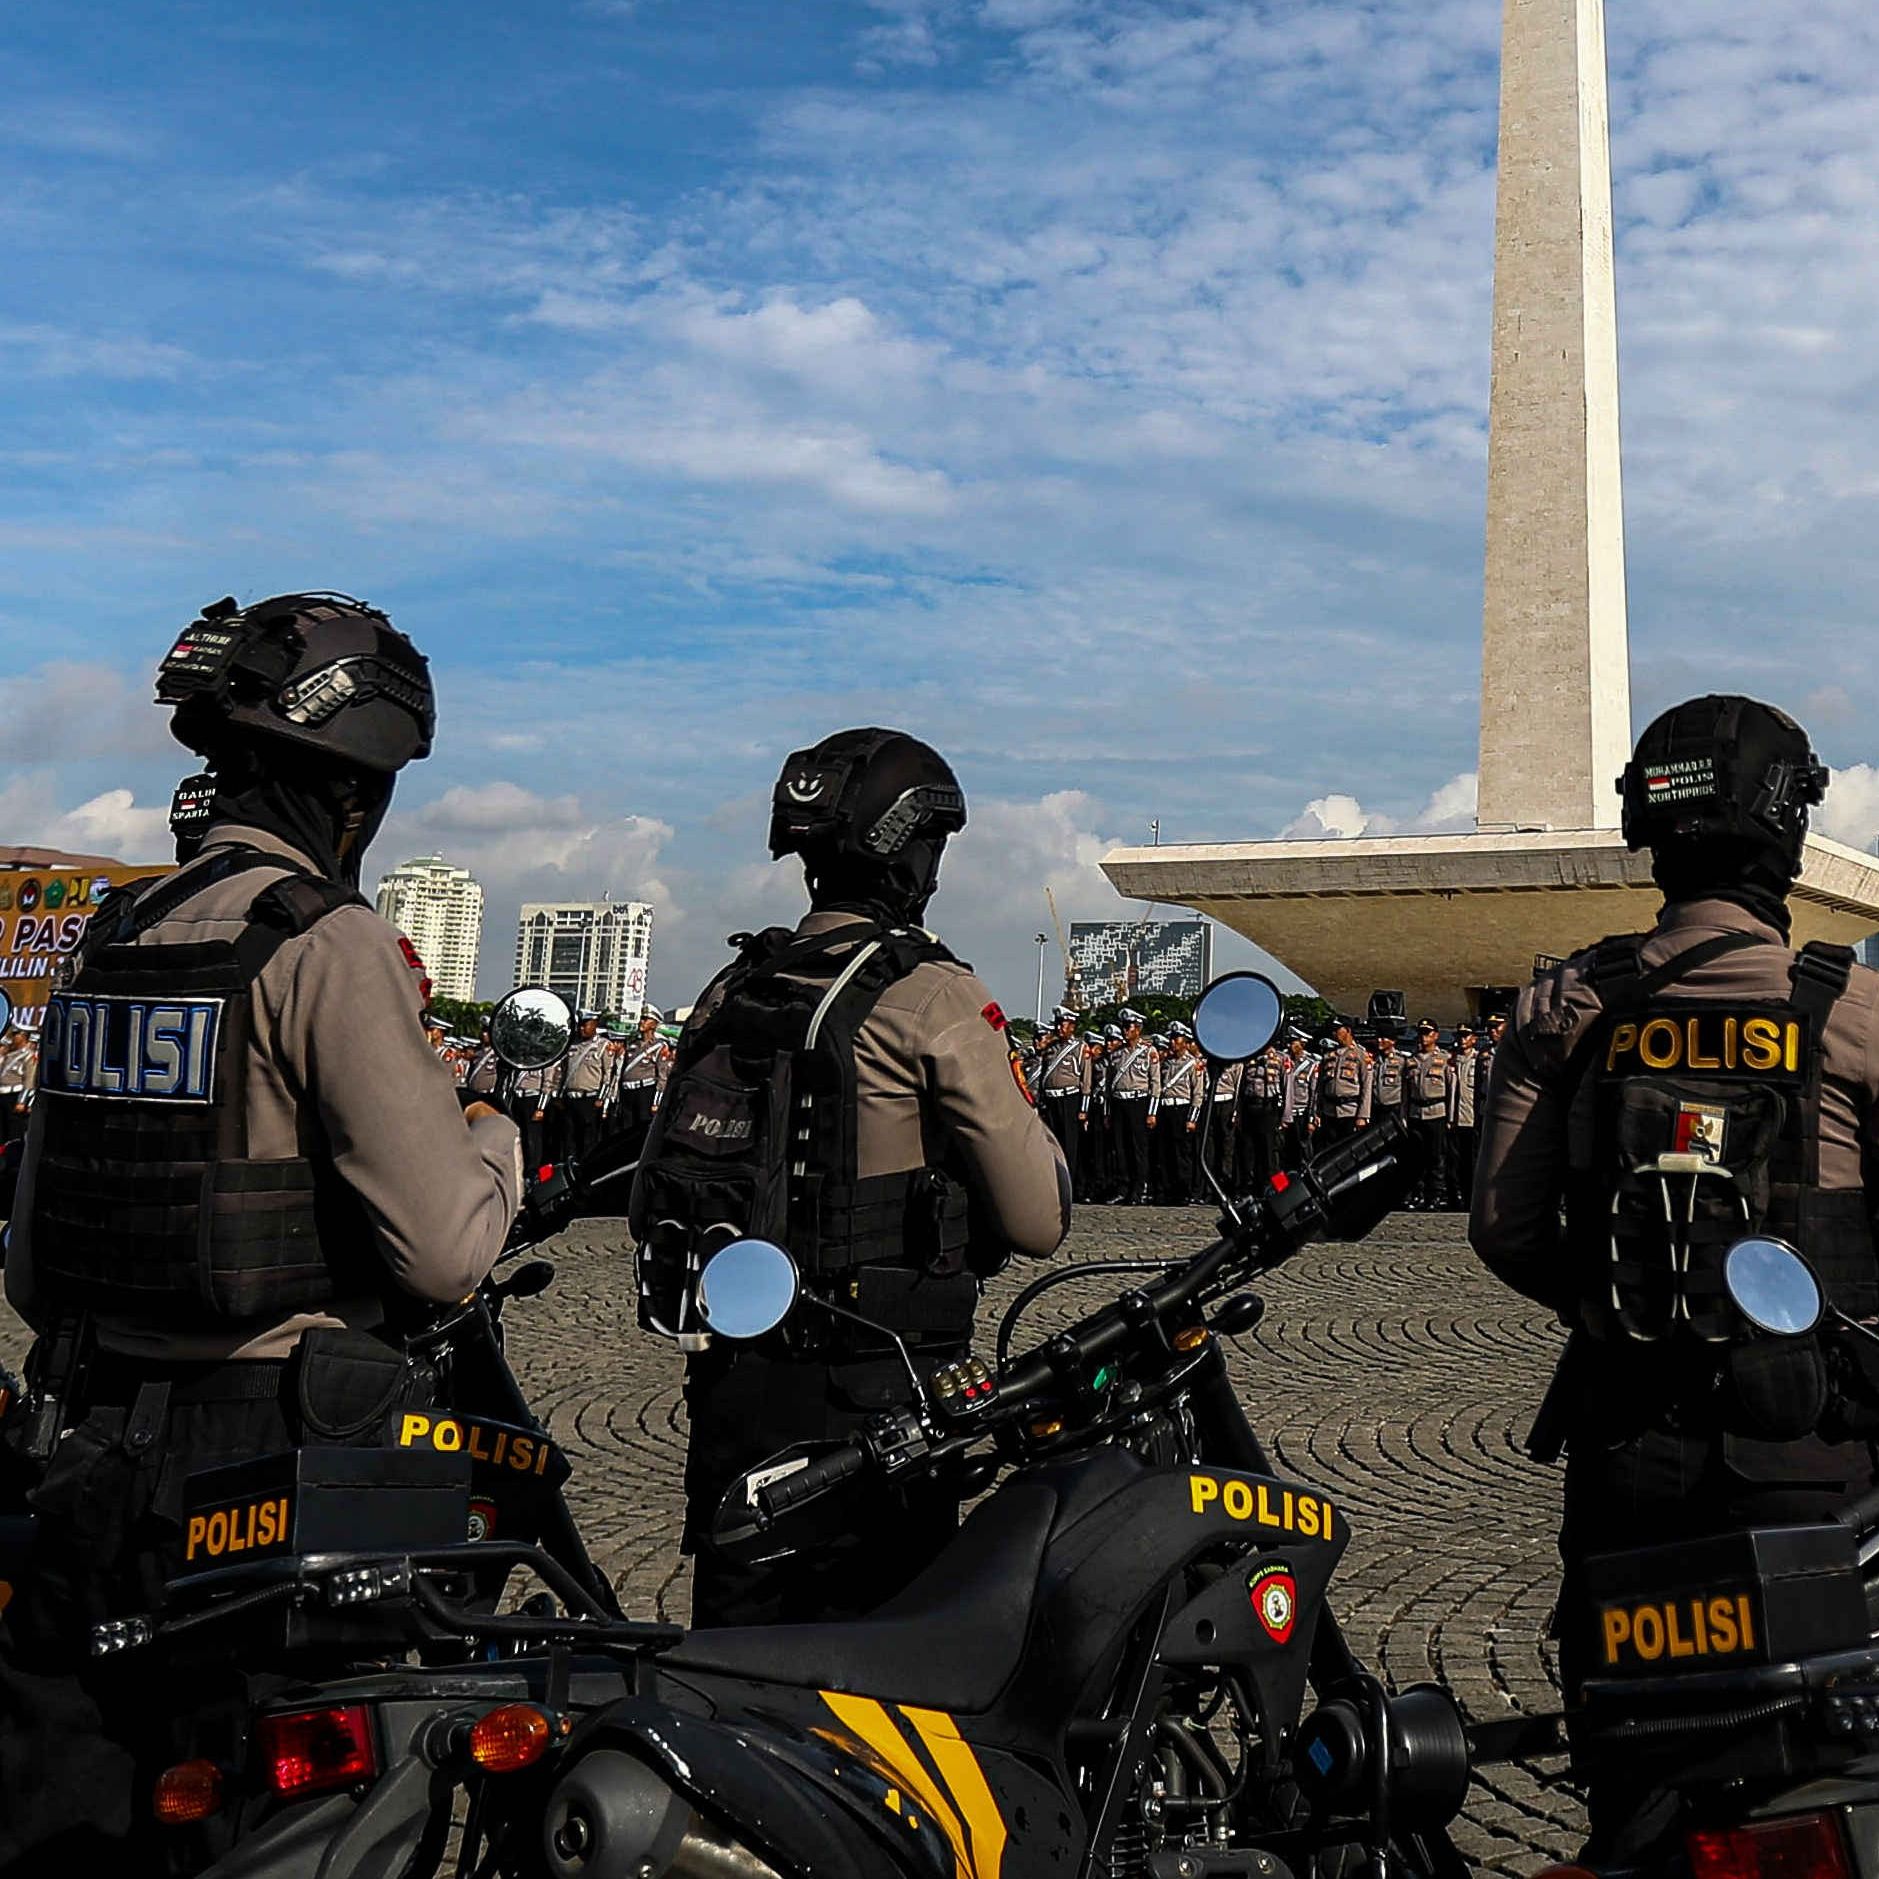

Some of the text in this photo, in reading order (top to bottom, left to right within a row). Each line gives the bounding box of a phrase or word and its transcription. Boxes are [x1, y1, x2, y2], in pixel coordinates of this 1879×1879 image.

[40, 1000, 212, 1095] POLISI
[1605, 1017, 1800, 1073] POLISI
[399, 1413, 550, 1476] POLISI
[186, 1498, 289, 1561] POLISI
[1189, 1474, 1333, 1542] POLISI
[1603, 1597, 1755, 1664] POLISI
